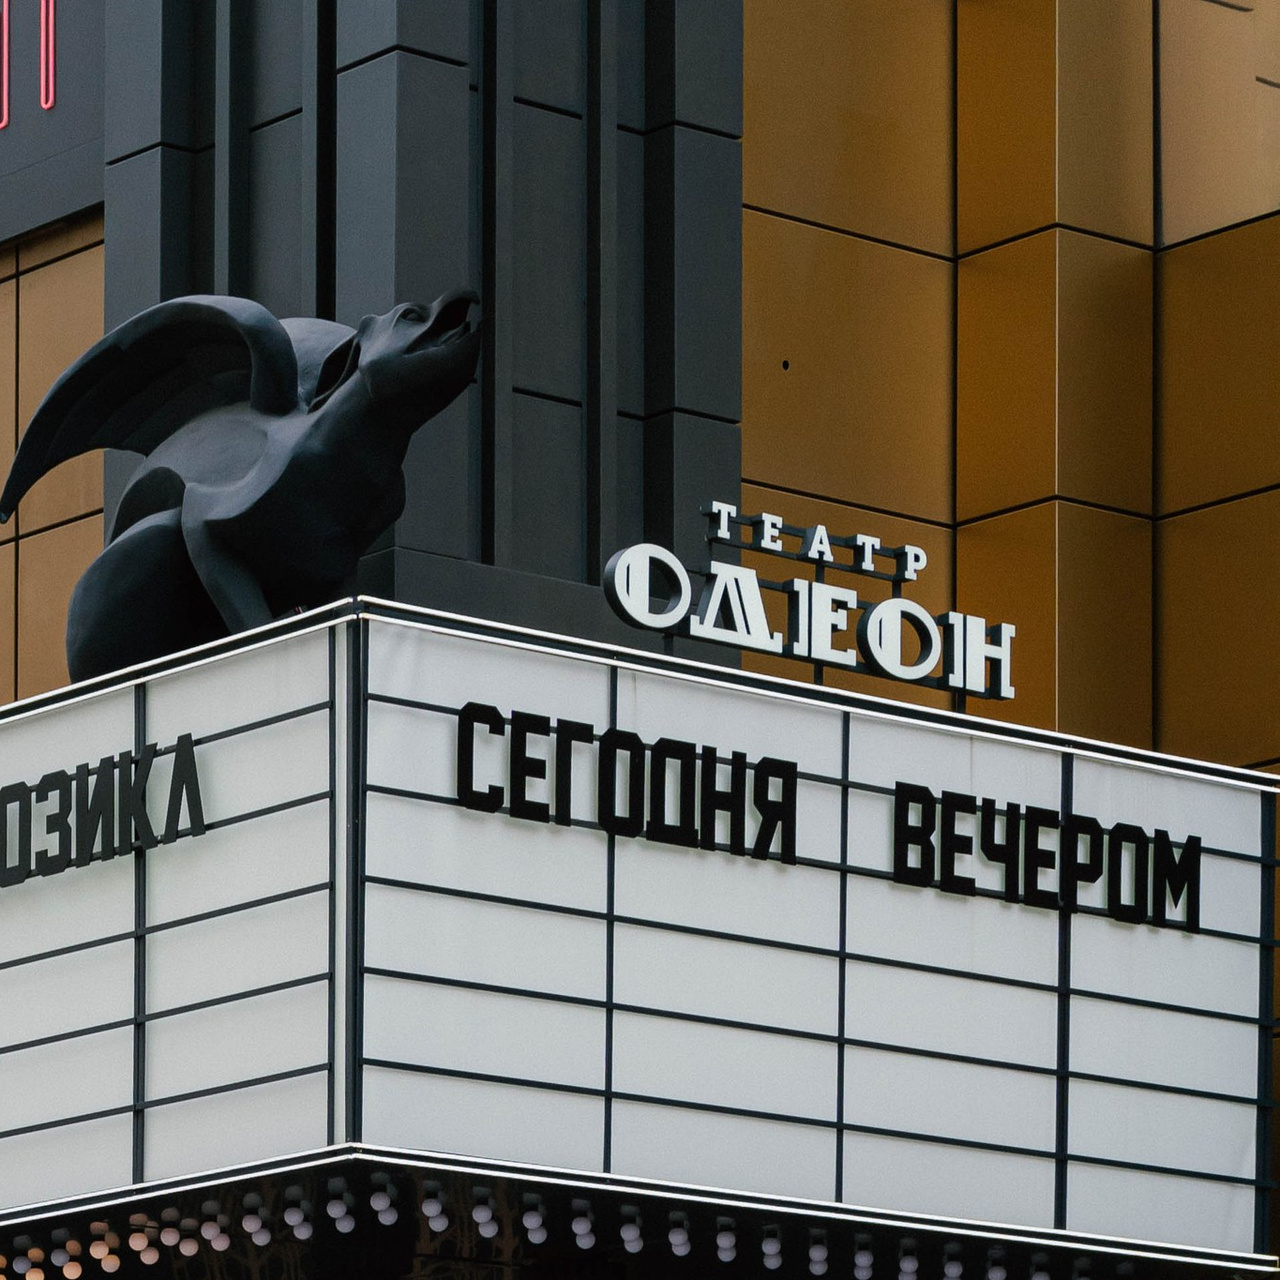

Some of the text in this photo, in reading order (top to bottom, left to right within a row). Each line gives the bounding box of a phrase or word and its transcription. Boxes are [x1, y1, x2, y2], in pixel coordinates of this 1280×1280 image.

[711, 500, 927, 581] ТЕАТР
[613, 543, 1016, 699] ОДЕОН
[457, 701, 1202, 934] СЕГОДНЯ ВЕЧЕРОМ
